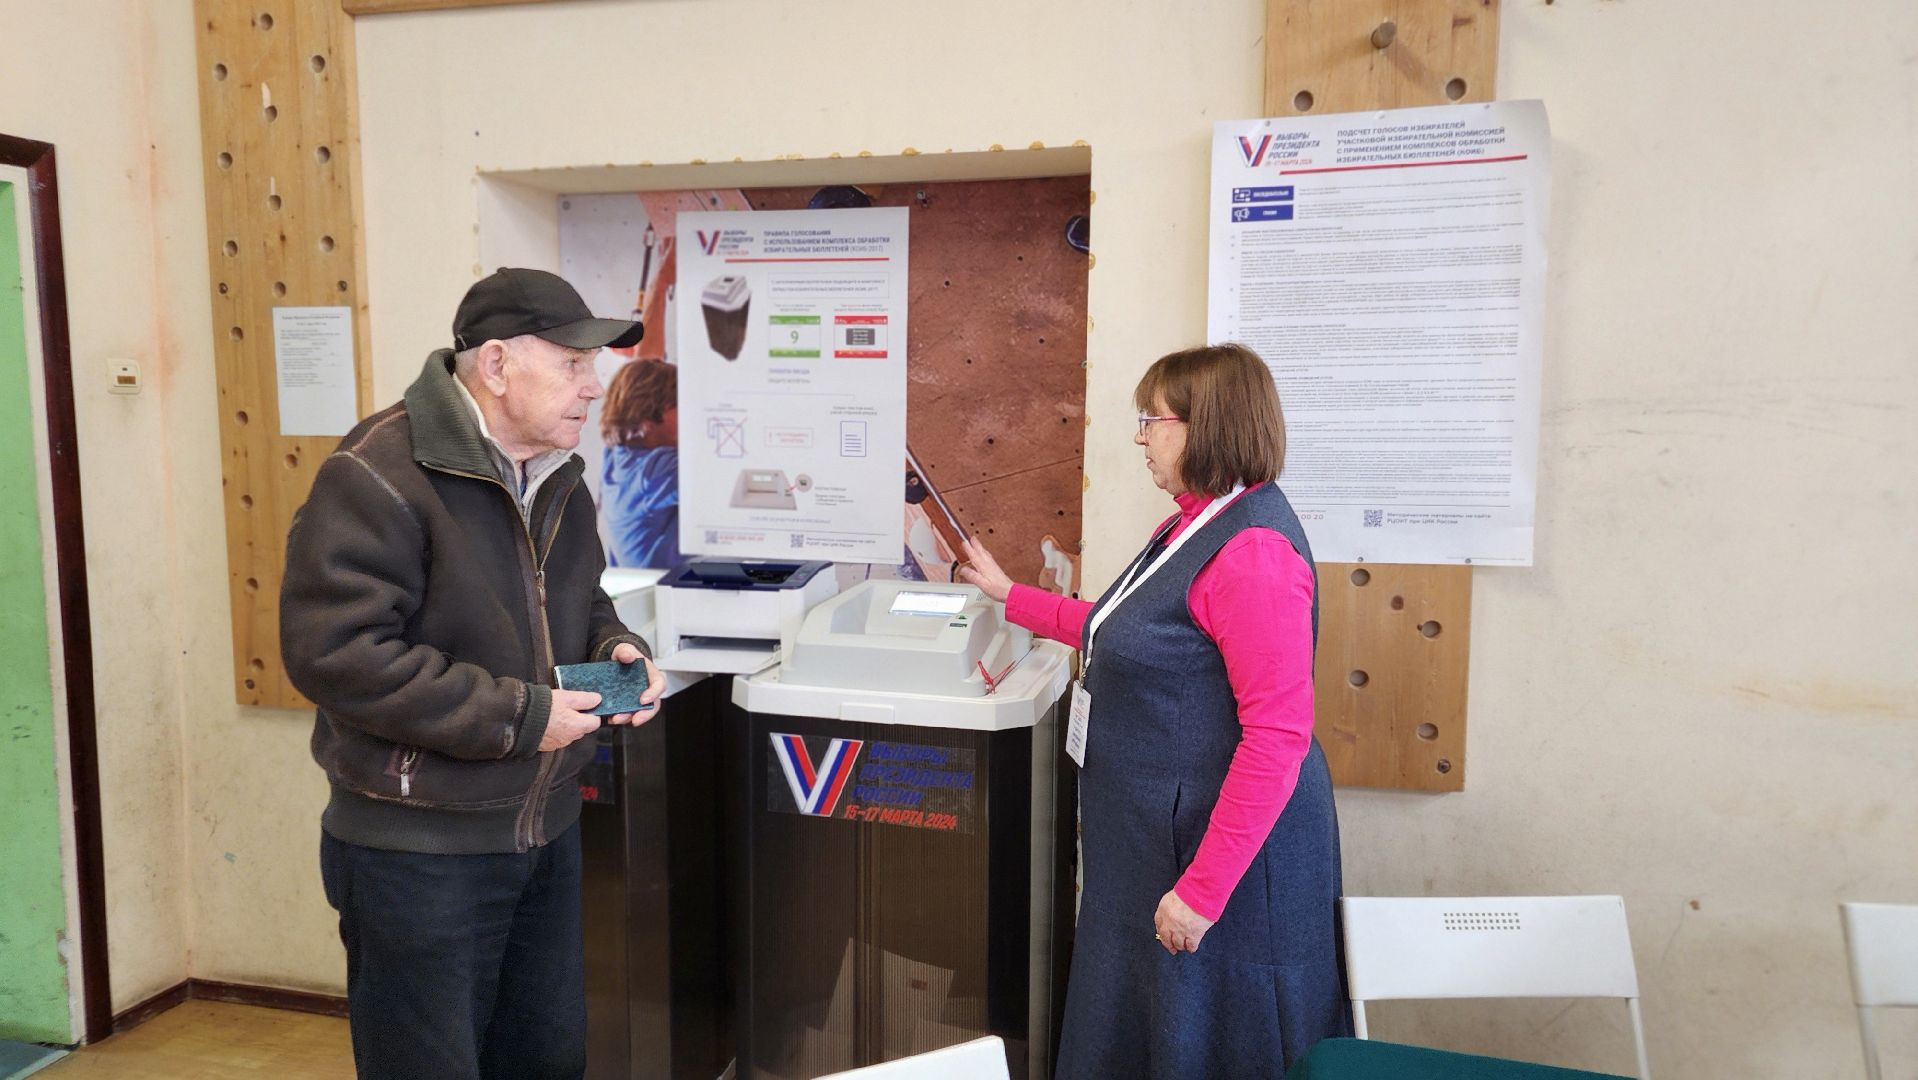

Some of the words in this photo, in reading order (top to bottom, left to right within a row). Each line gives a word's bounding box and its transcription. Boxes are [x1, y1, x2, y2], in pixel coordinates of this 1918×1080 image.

[1276, 132, 1311, 141] ВЫБОРЫ
[1337, 128, 1372, 137] ПОДСЧЕТ
[1373, 126, 1409, 134] ГОЛОСОВ
[1410, 120, 1466, 131] ИЗБИРАТЕЛЕЙ
[1337, 136, 1386, 146] УЧАСТКОВОЙ
[1387, 131, 1454, 143] ИЗБИРАТЕЛЬНОЙ
[1455, 126, 1505, 138] КОМИССИЕЙ
[1272, 140, 1320, 150] ПРЕЗИДЕНТА
[1343, 143, 1402, 154] ПРИМЕНЕНИЕМ
[1402, 140, 1457, 150] КОМПЛЕКСОВ
[1458, 136, 1505, 147] ОБРАБОТКИ
[1267, 151, 1299, 159] РОССИИ
[1336, 152, 1402, 164] ИЗБИРАТЕЛЬНЫХ
[1403, 149, 1456, 159] БЮЛЛЕТЕНЕЙ
[1457, 148, 1485, 157] (КОИБ)
[790, 330, 800, 344] 9
[869, 741, 949, 764] ВЫБОРЫ
[859, 763, 974, 789] ПРЕЗИДЕНТА
[851, 784, 925, 805] РОССИИ
[879, 807, 924, 826] МАРТА
[924, 812, 957, 830] 2024
